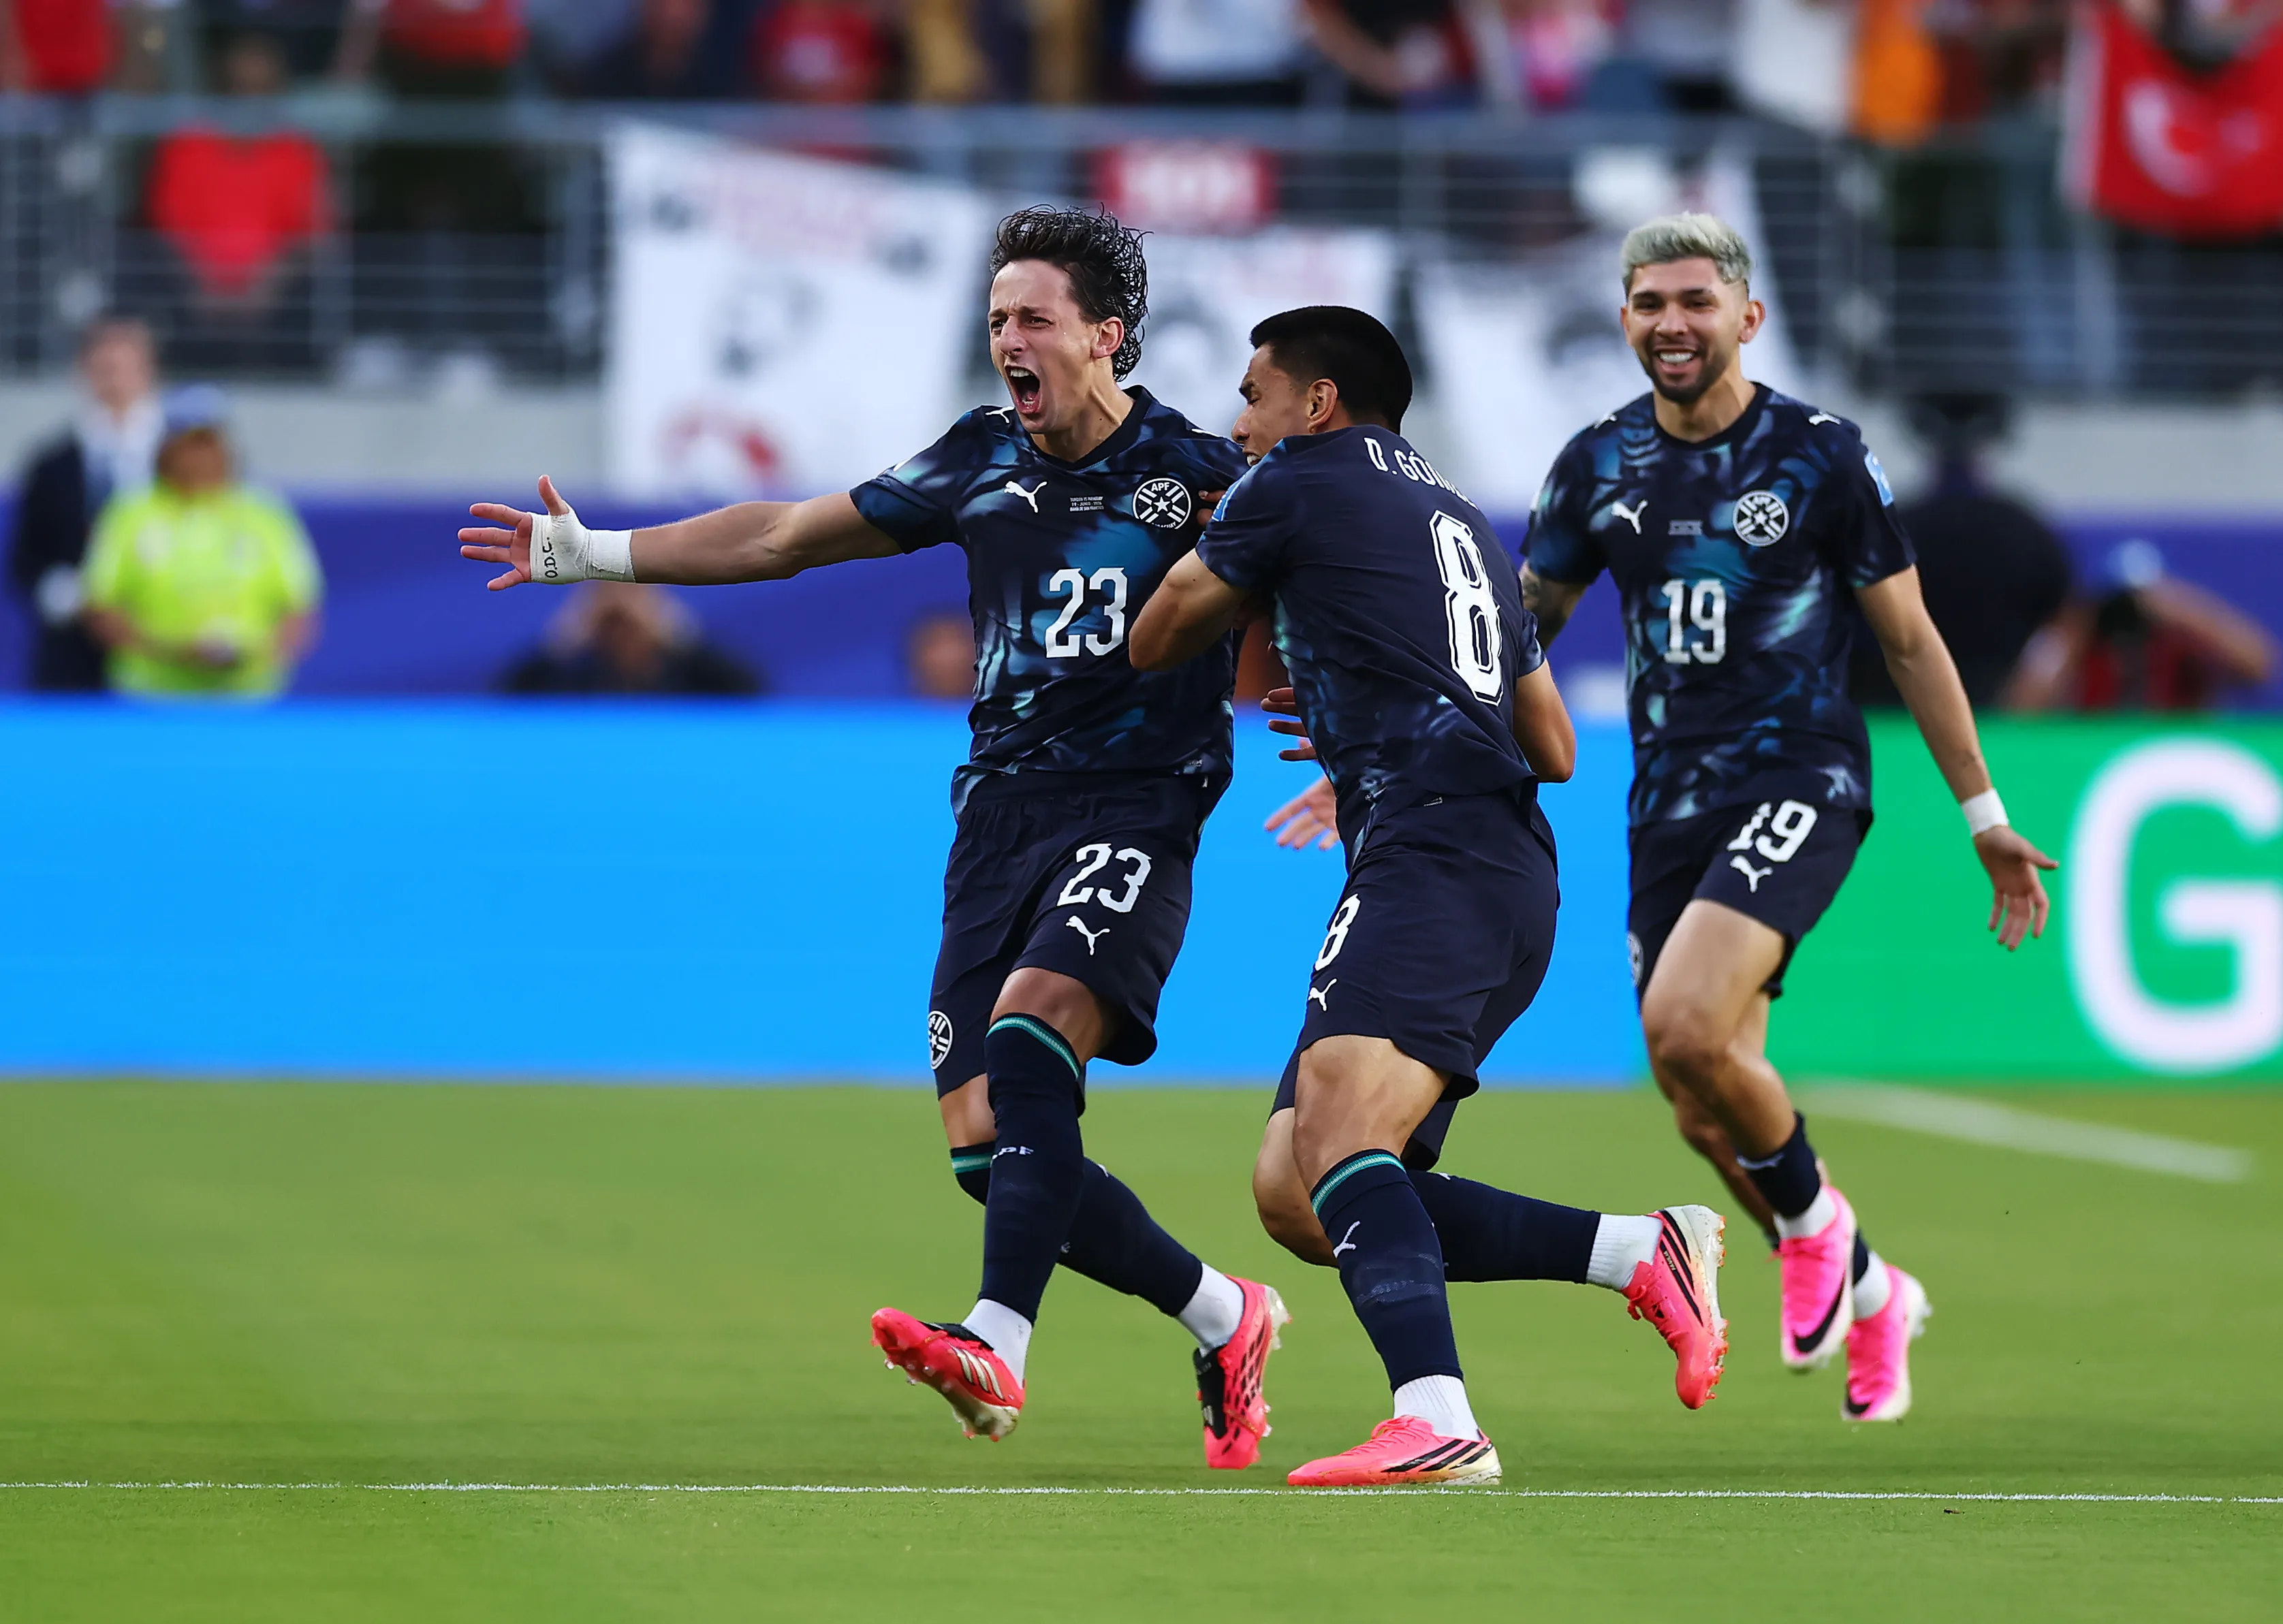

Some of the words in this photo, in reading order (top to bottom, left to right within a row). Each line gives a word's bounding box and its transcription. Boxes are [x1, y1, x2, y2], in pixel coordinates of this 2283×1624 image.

[1151, 482, 1170, 492] APF
[542, 537, 558, 578] O.D.C.
[1045, 567, 1128, 658] 23
[1429, 509, 1504, 707] 8
[1661, 579, 1727, 665] 19
[1727, 799, 1818, 863] 19
[1056, 843, 1152, 913] 23
[2064, 735, 2283, 1076] G
[1314, 893, 1361, 971] 8
